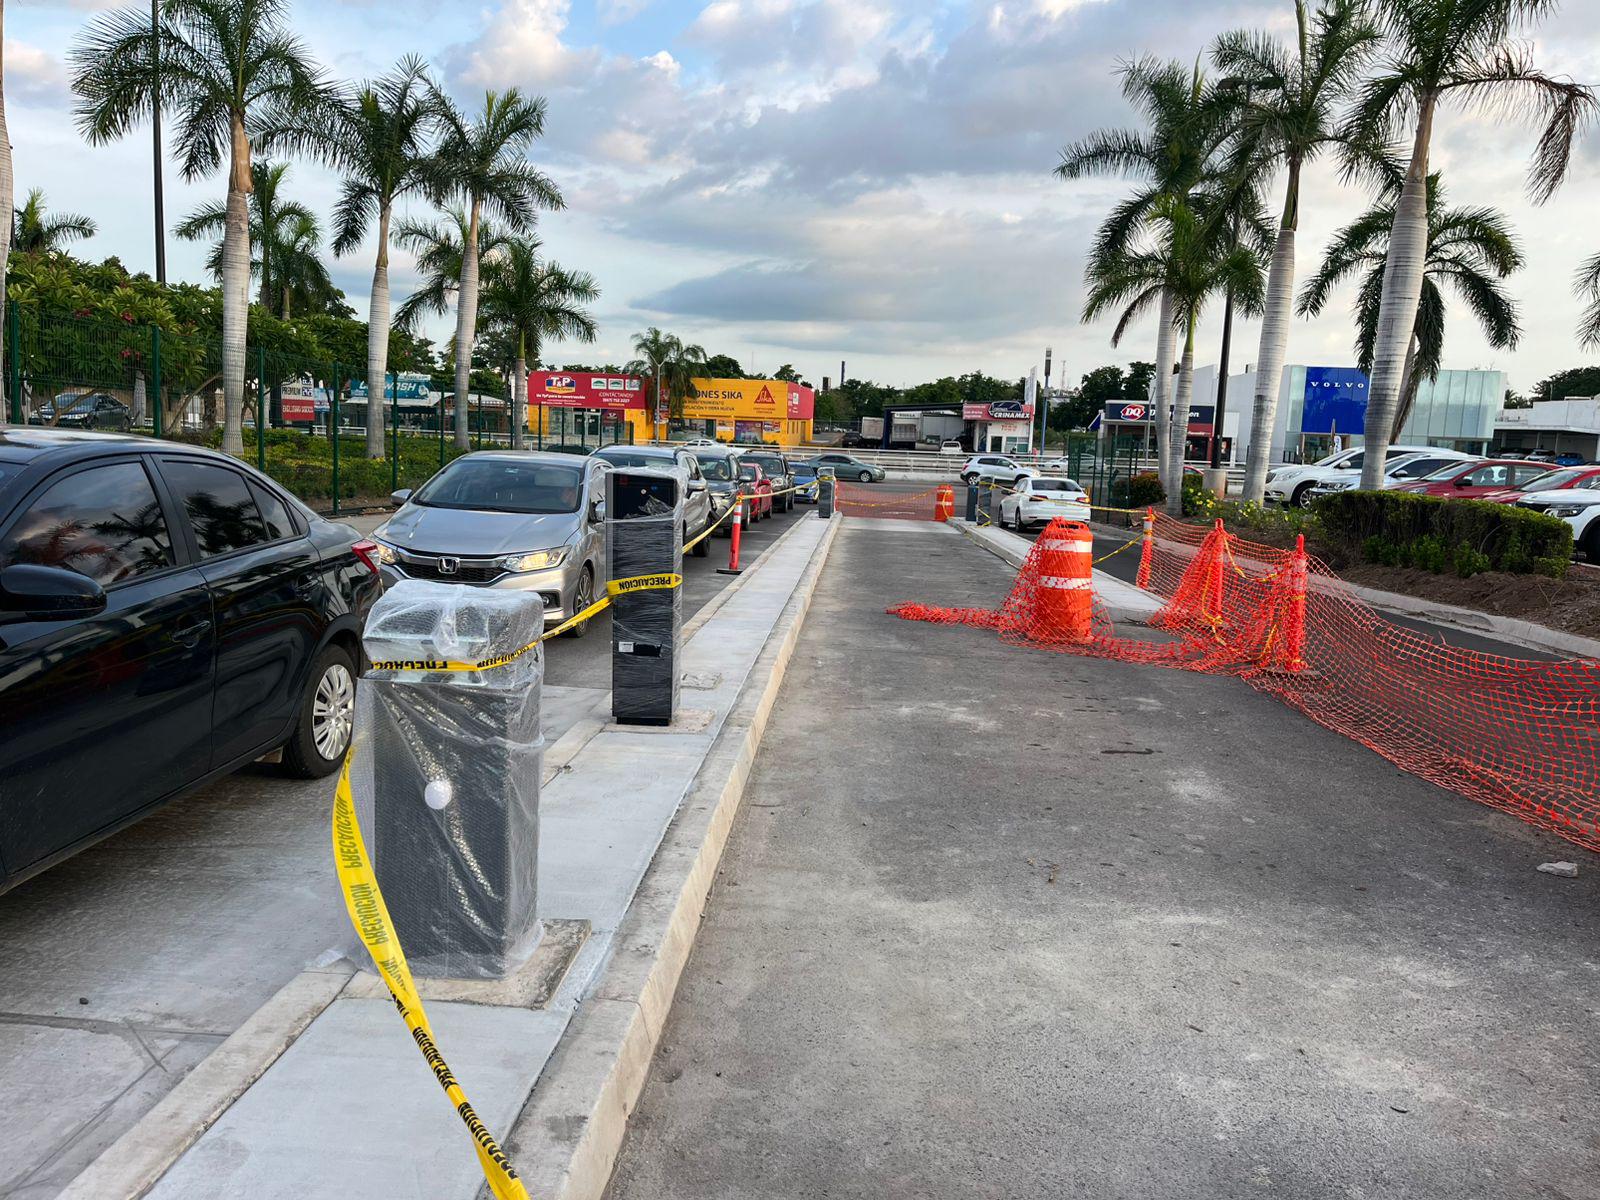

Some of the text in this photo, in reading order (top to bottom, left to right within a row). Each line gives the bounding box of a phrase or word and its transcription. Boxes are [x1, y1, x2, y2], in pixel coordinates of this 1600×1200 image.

[551, 377, 570, 387] T&P
[722, 391, 743, 400] SIKA
[1125, 408, 1142, 416] DQ
[618, 576, 671, 591] PRECAUCIÓN
